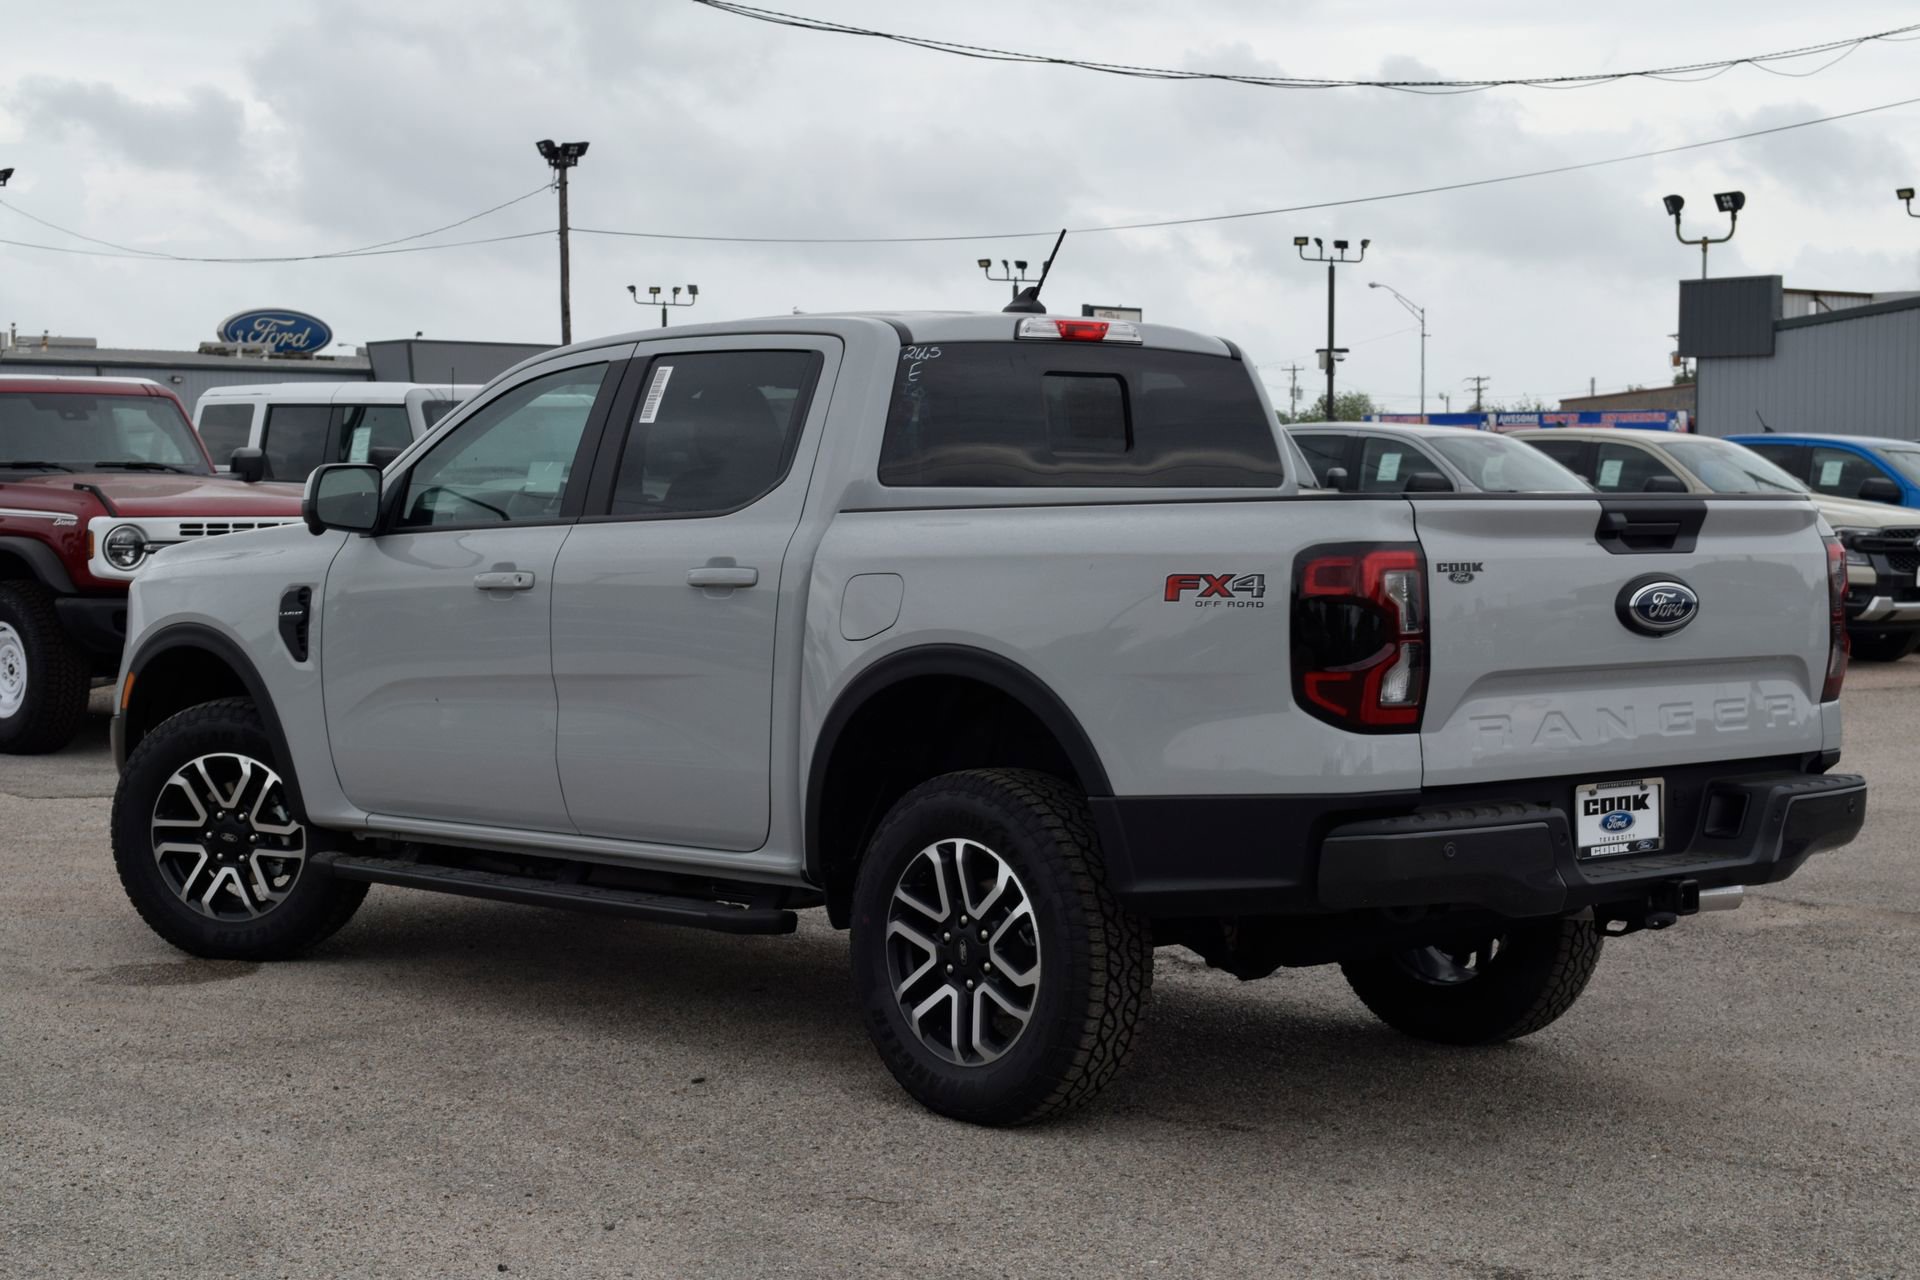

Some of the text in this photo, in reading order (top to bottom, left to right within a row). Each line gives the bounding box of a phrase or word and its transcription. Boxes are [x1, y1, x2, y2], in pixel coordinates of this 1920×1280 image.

[247, 317, 312, 348] Ford
[908, 360, 923, 382] E
[1498, 413, 1540, 424] AWESOME
[1436, 562, 1484, 573] COOK
[1164, 573, 1266, 602] FX4
[1195, 600, 1221, 608] OFF
[1648, 591, 1686, 618] Ford
[1468, 693, 1800, 752] RANGER
[1583, 793, 1651, 817] COOK
[1606, 815, 1628, 829] Ford
[1591, 843, 1630, 856] COOK
